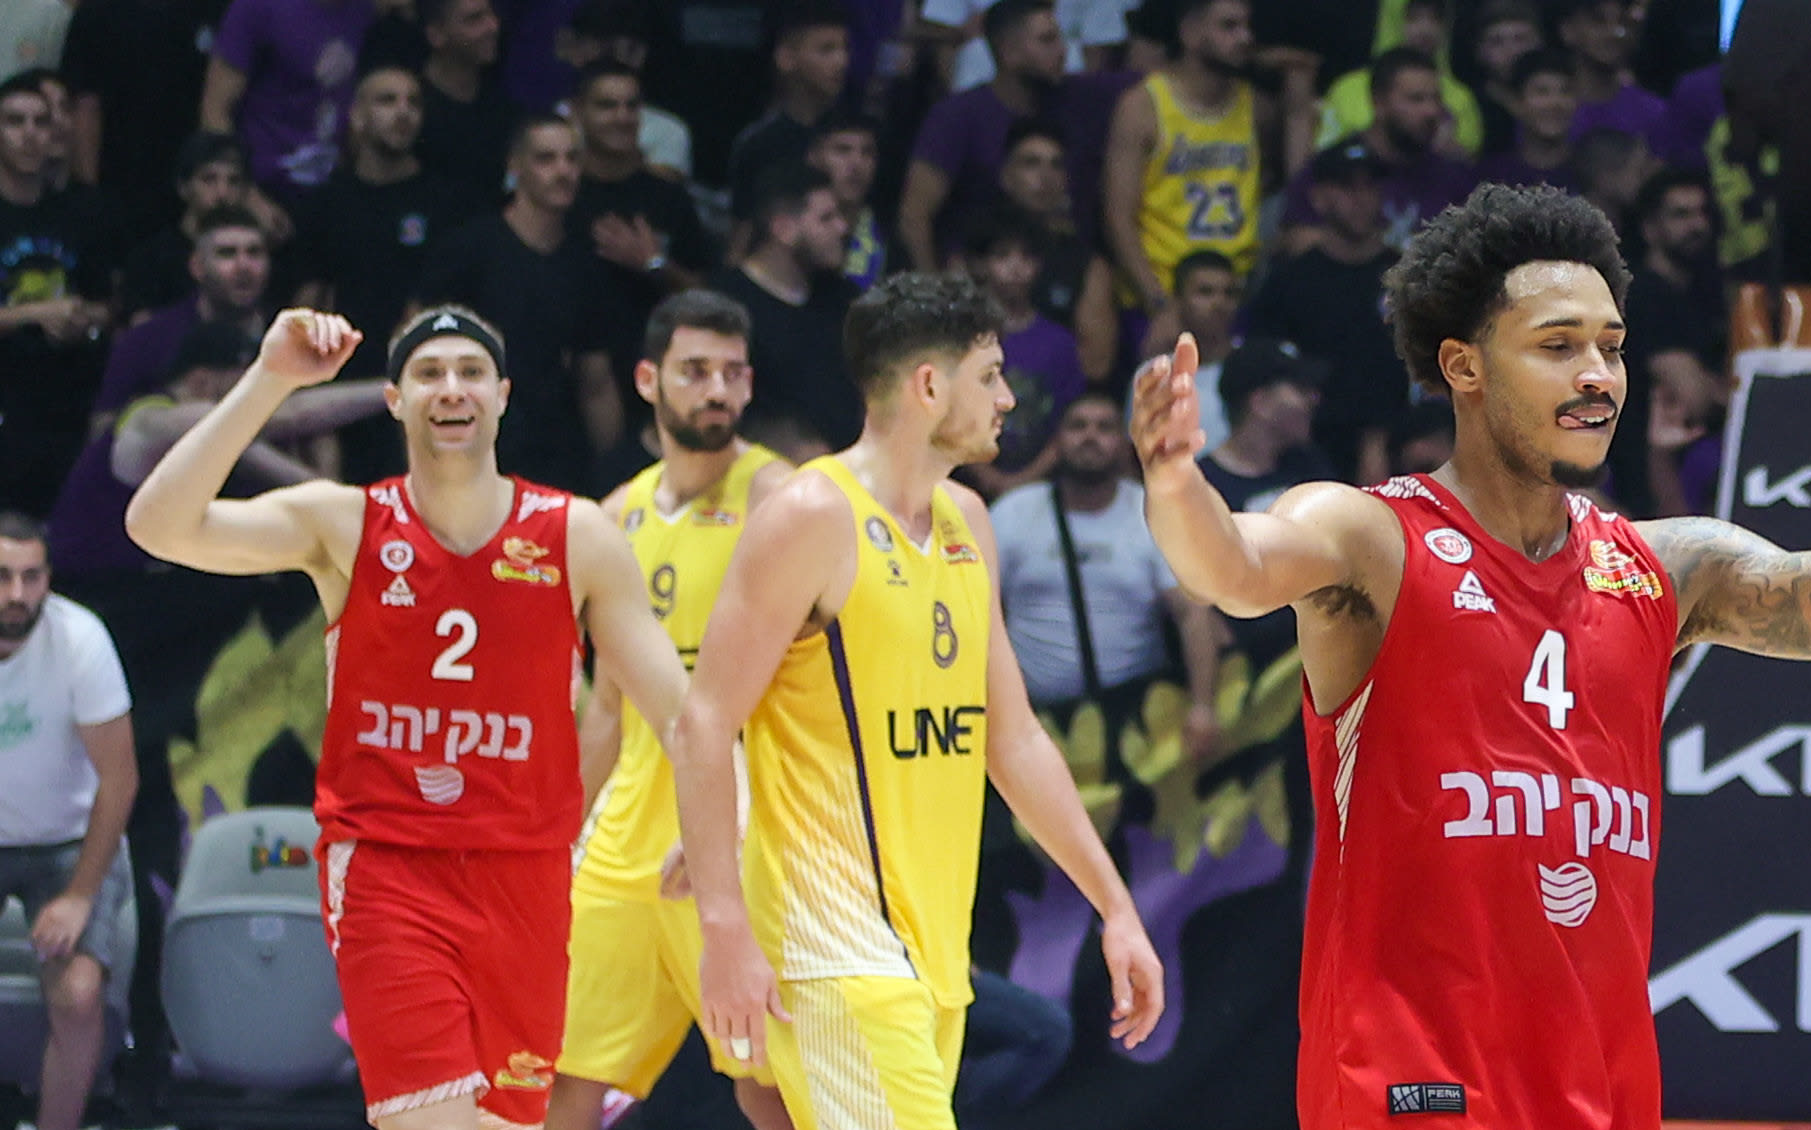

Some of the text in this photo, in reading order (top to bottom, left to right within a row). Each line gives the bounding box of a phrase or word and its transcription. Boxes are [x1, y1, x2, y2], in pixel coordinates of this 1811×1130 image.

[1186, 182, 1245, 240] 23
[651, 563, 677, 621] 9
[1453, 590, 1497, 614] PEAK
[431, 609, 478, 681] 2
[932, 600, 958, 669] 8
[1523, 629, 1574, 730] 4
[357, 700, 532, 763] בנק יהב
[1440, 770, 1651, 860] בנק יהב
[1428, 1089, 1461, 1098] PEAK
